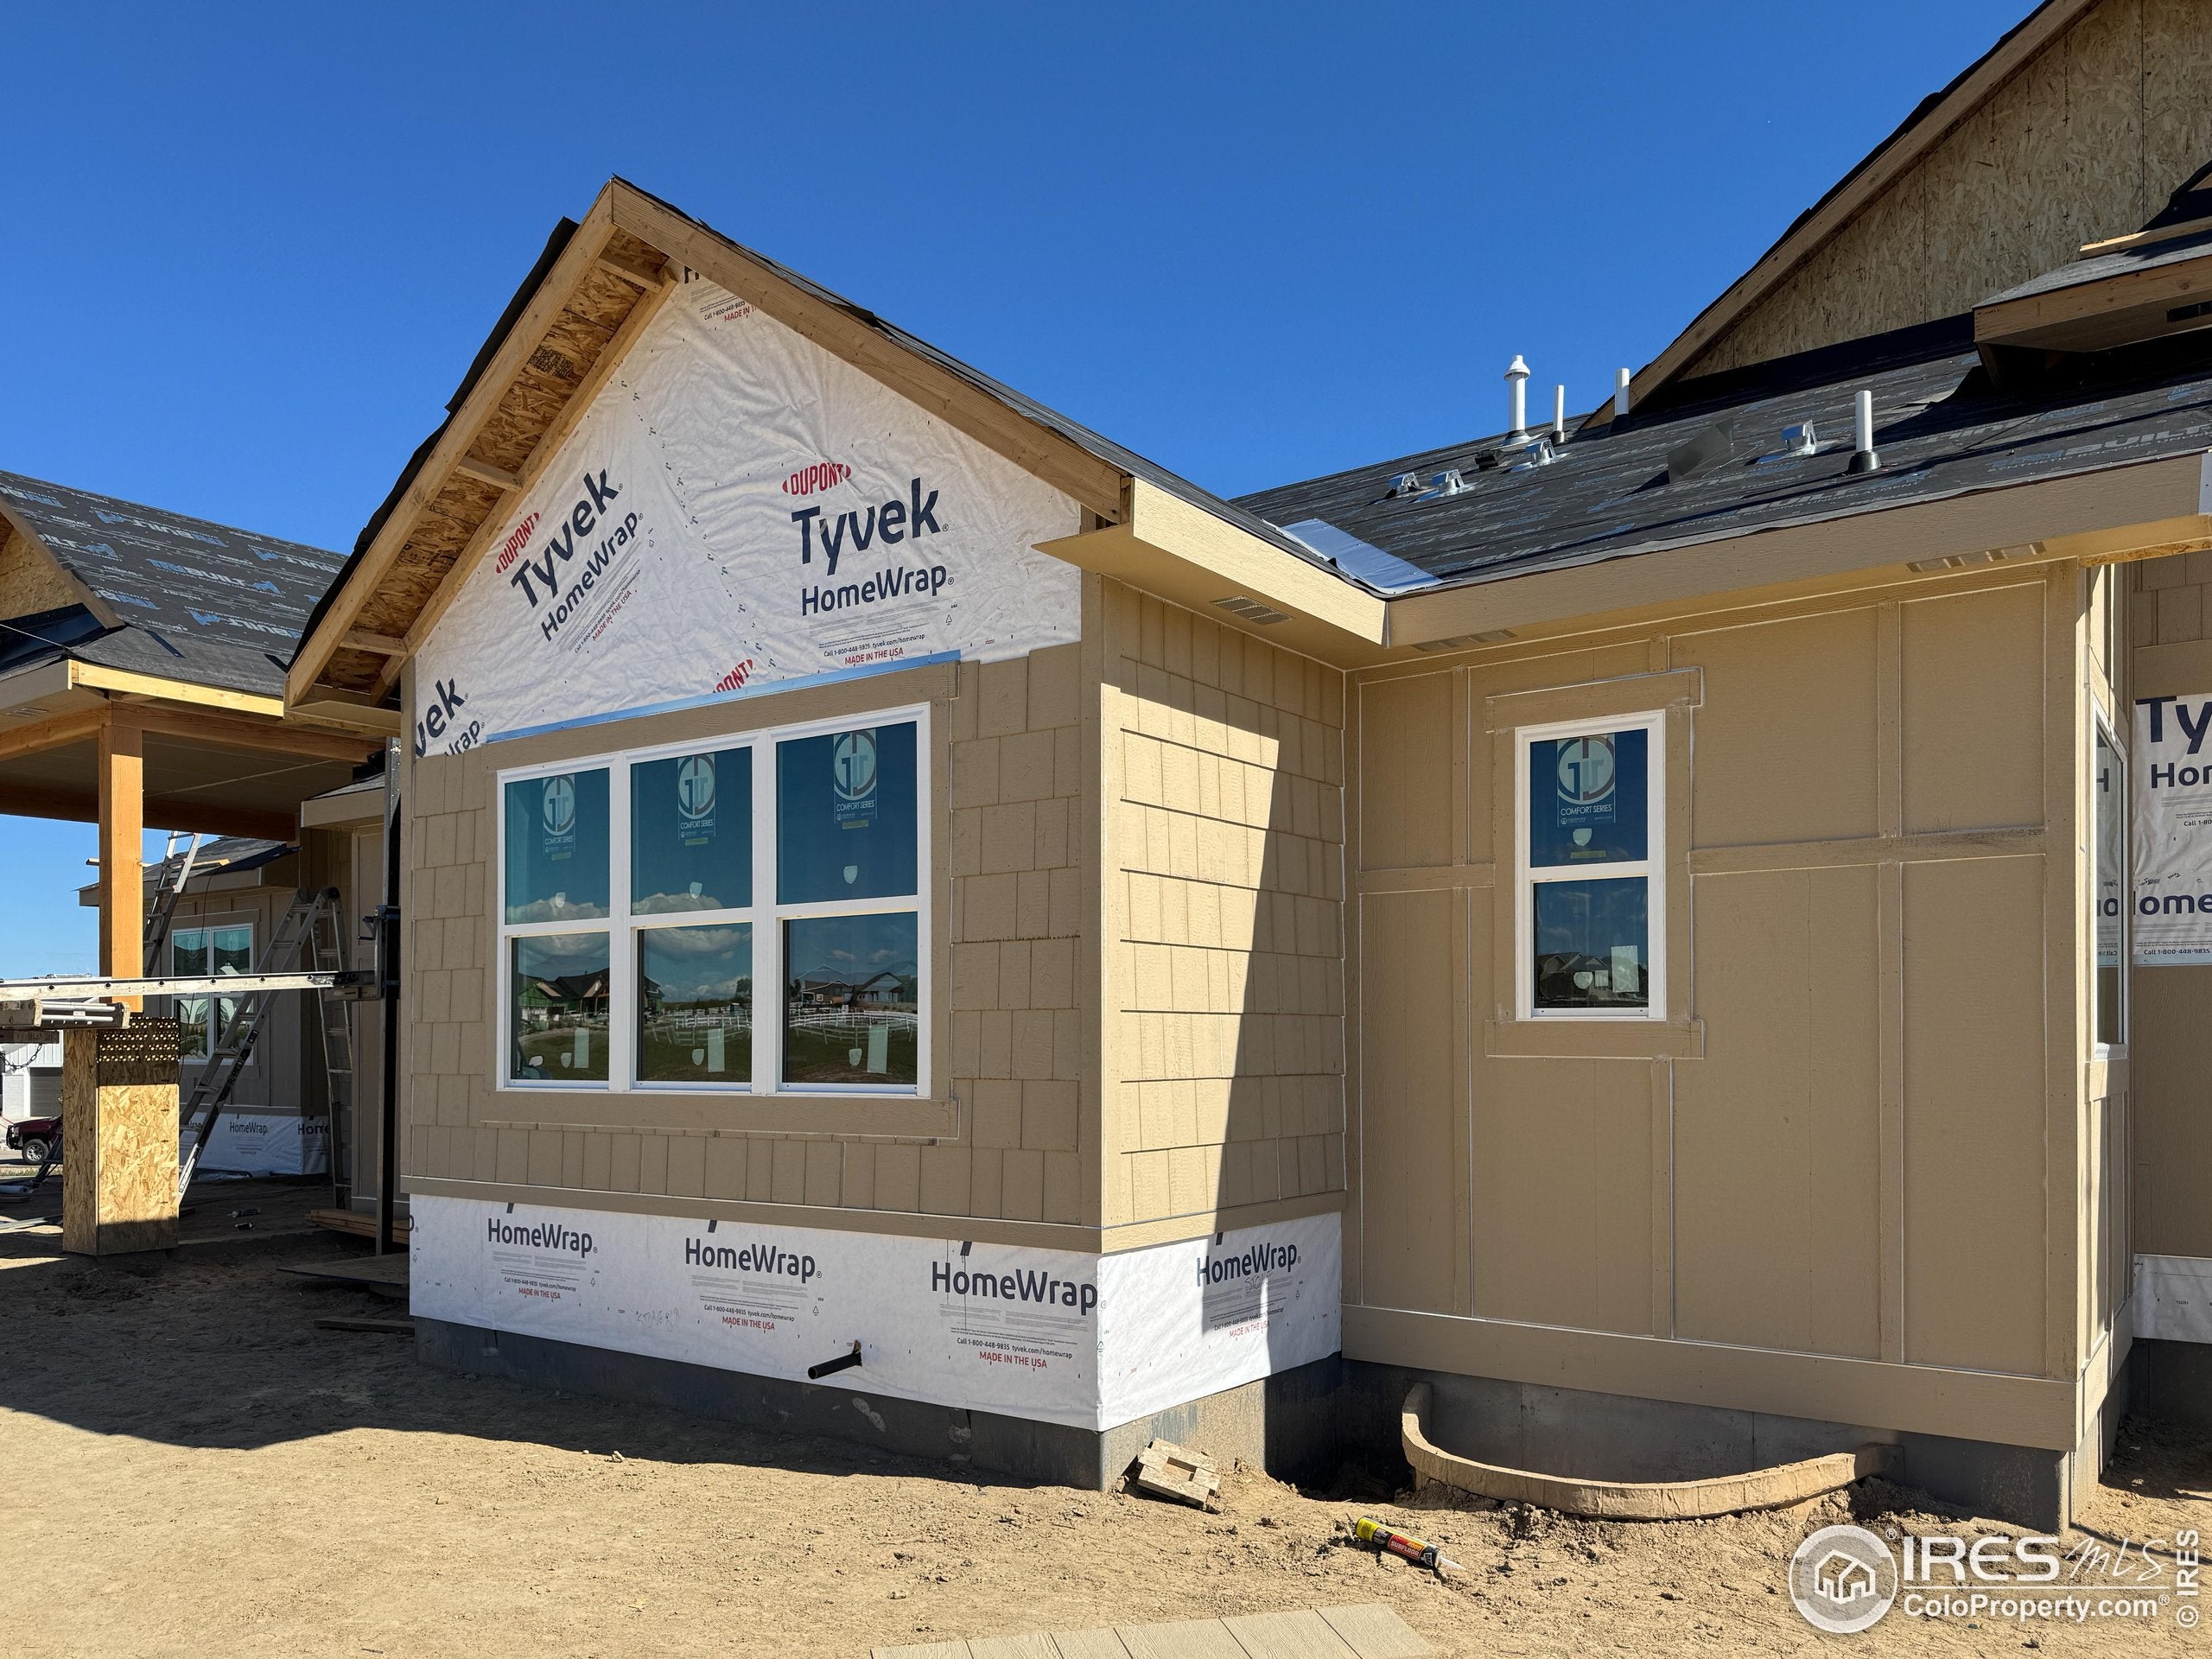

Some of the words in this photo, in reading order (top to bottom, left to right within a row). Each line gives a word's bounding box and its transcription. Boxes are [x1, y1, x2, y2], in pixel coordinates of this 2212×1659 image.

[791, 477, 941, 575] Tyvek
[511, 469, 620, 608] Tyvek
[541, 512, 639, 642] HomeWrap
[802, 564, 947, 616] HomeWrap
[592, 624, 607, 642] MADE
[611, 603, 623, 617] THE
[620, 590, 632, 604] USA
[872, 633, 925, 649] tyvek.com/homewrap
[844, 653, 865, 665] MADE
[866, 652, 874, 662] IN
[874, 650, 888, 660] THE
[889, 646, 904, 658] USA
[836, 801, 861, 812] COMFORT
[860, 800, 875, 810] SERIES
[1560, 805, 1592, 816] COMFORT
[1592, 804, 1613, 813] SERIES
[680, 819, 701, 830] COMFORT
[701, 818, 714, 828] SERIES
[544, 836, 563, 845] COMFORT
[563, 835, 574, 843] SERIES
[229, 1121, 268, 1136] HomeWrap
[487, 1217, 593, 1259] HomeWrap
[685, 1237, 817, 1284] HomeWrap
[1197, 1242, 1298, 1287] HomeWrap
[518, 1287, 533, 1296] MADE
[539, 1290, 550, 1299] THE
[931, 1259, 1098, 1316] HomeWrap
[712, 1306, 747, 1316] 1-800-448-9835
[747, 1310, 795, 1322] tyvek.com/homewrap
[721, 1316, 741, 1326] MADE
[741, 1319, 749, 1327] IN
[749, 1319, 762, 1329] THE
[762, 1322, 776, 1331] USA
[1229, 1325, 1244, 1339] MADE
[1250, 1321, 1260, 1332] THE
[957, 1337, 968, 1345] Call
[968, 1338, 1010, 1351] 1-800-448-9835
[1012, 1344, 1073, 1360] tyvek.com/homewrap
[979, 1351, 1003, 1363] MADE
[1003, 1355, 1013, 1364] IN
[1014, 1356, 1030, 1366] THE
[1031, 1359, 1048, 1369] USA
[1390, 1541, 1420, 1556] SUBFLOOR
